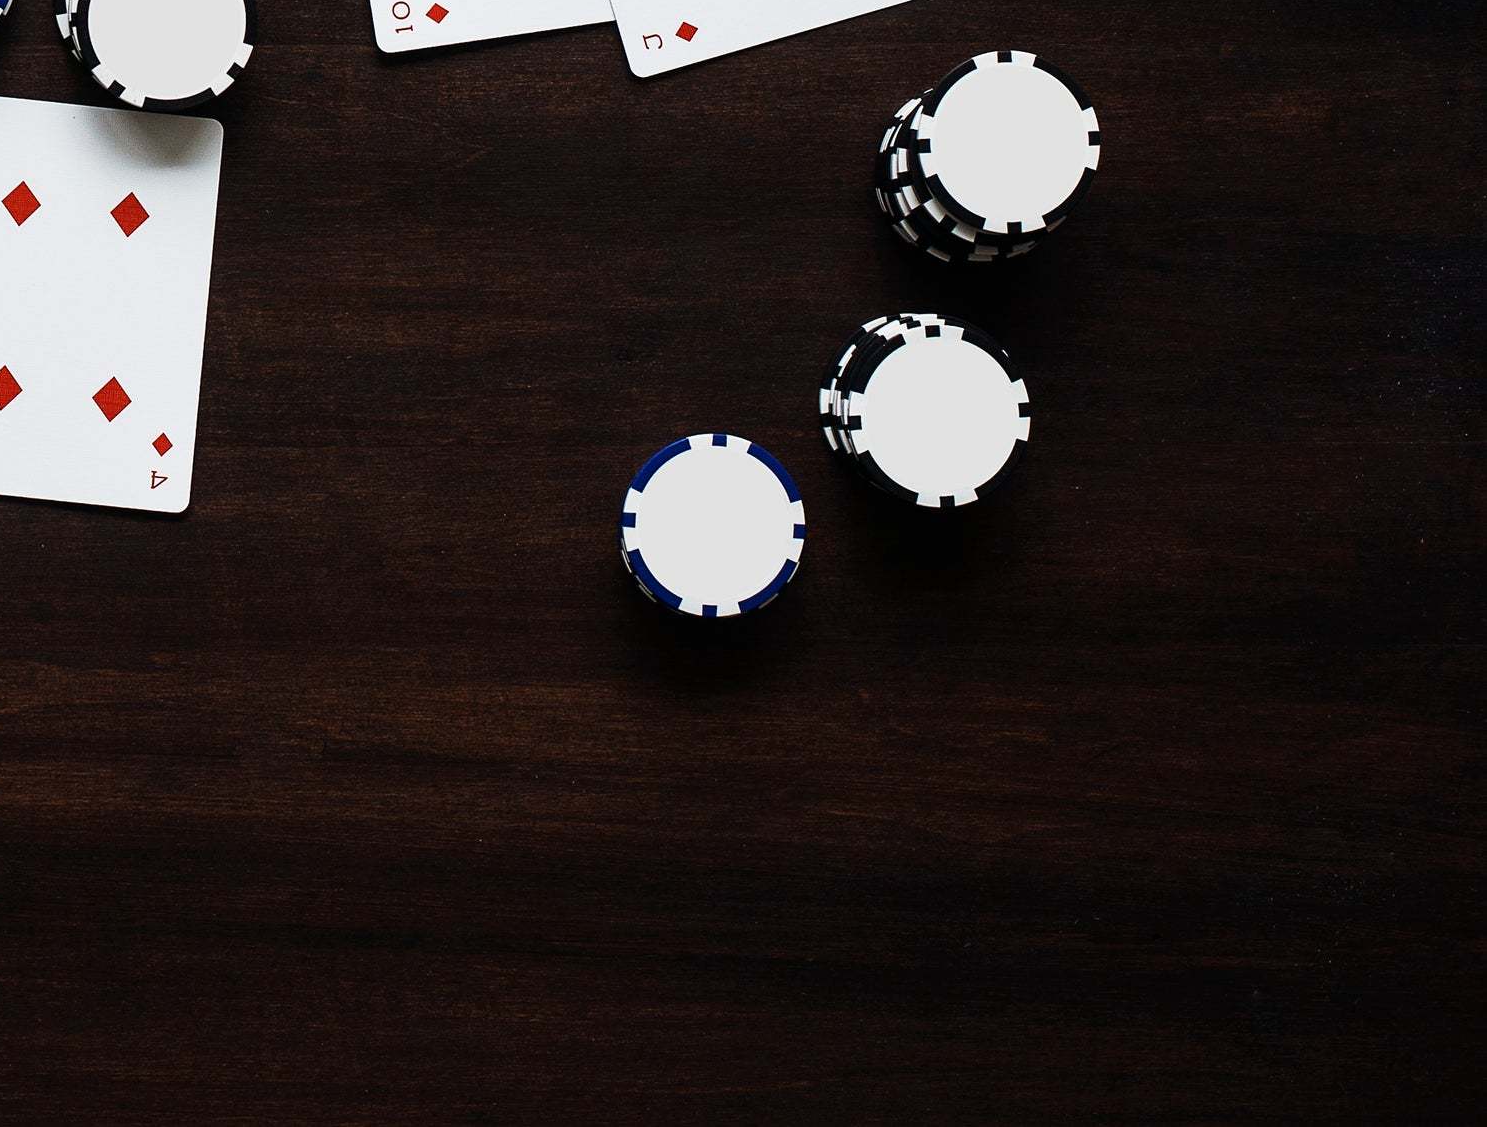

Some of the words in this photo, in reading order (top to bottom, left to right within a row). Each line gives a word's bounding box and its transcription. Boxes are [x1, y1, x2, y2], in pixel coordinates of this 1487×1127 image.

[391, 0, 414, 34] 10
[642, 33, 664, 50] J
[150, 470, 169, 490] 4
